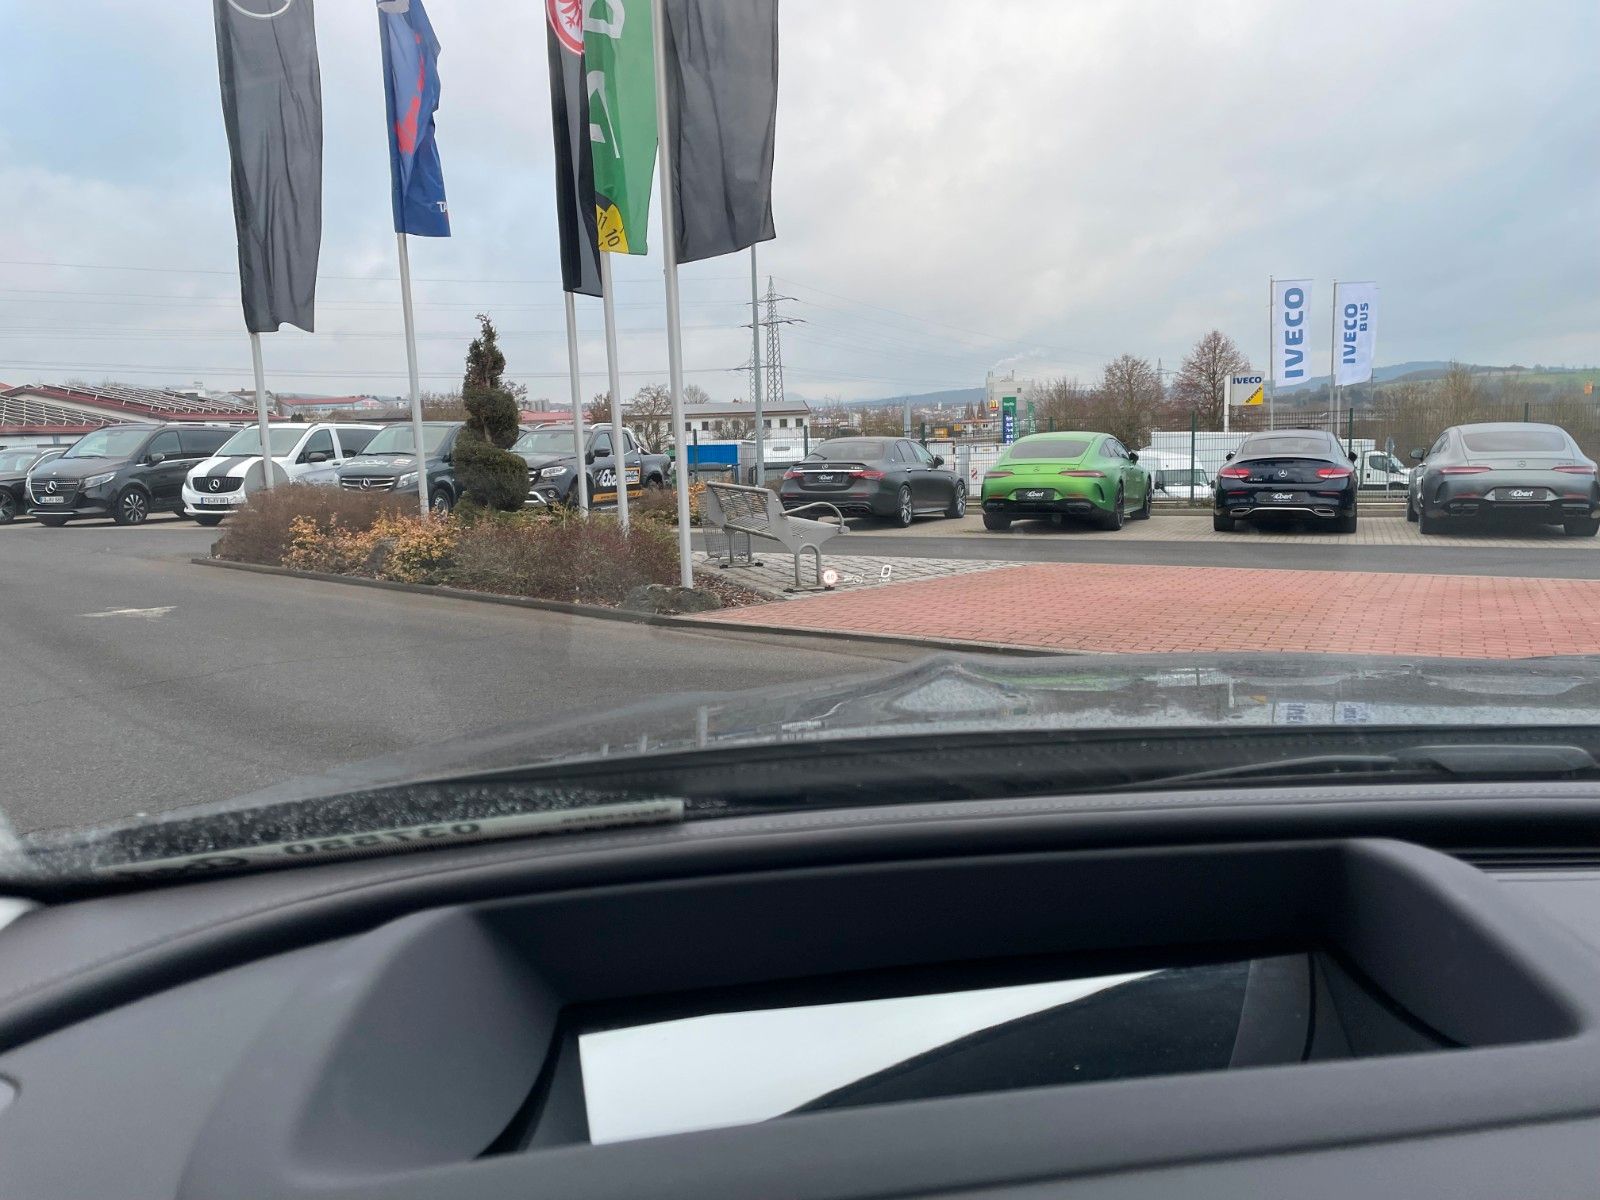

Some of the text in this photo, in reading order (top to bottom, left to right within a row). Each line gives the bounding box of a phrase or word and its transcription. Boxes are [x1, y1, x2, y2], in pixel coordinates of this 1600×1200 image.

[605, 228, 621, 247] 10
[1359, 302, 1369, 332] BUS
[1284, 287, 1304, 378] IVECO
[1342, 303, 1358, 364] IVECO
[1232, 376, 1262, 384] IVECO
